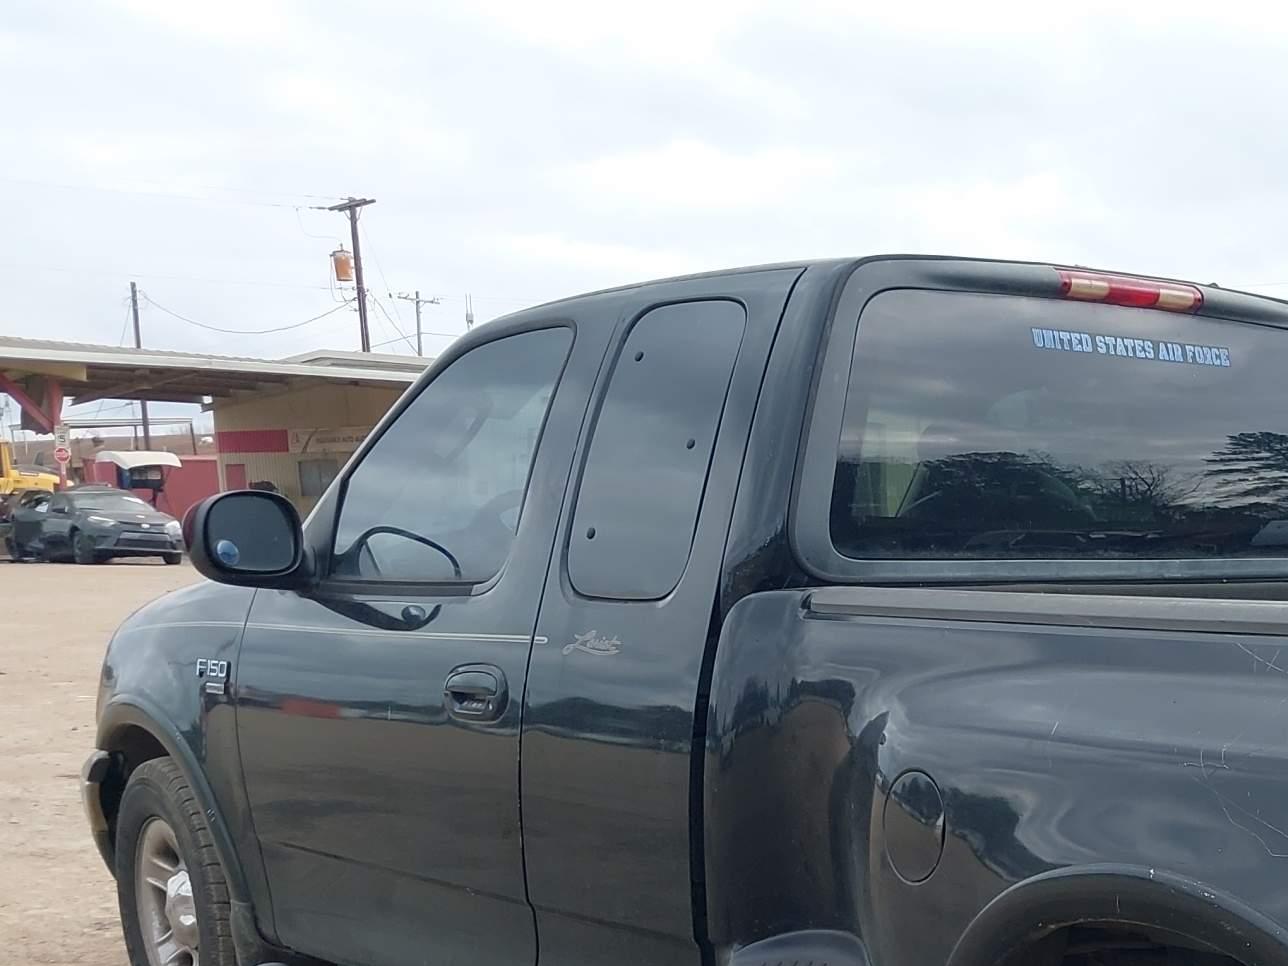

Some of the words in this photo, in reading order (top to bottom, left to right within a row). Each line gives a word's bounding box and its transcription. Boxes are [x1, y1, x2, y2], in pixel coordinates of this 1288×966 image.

[1031, 327, 1093, 353] UNITED
[1095, 335, 1155, 359] STATES
[1158, 342, 1184, 362] AIR
[1184, 345, 1231, 367] FORCE
